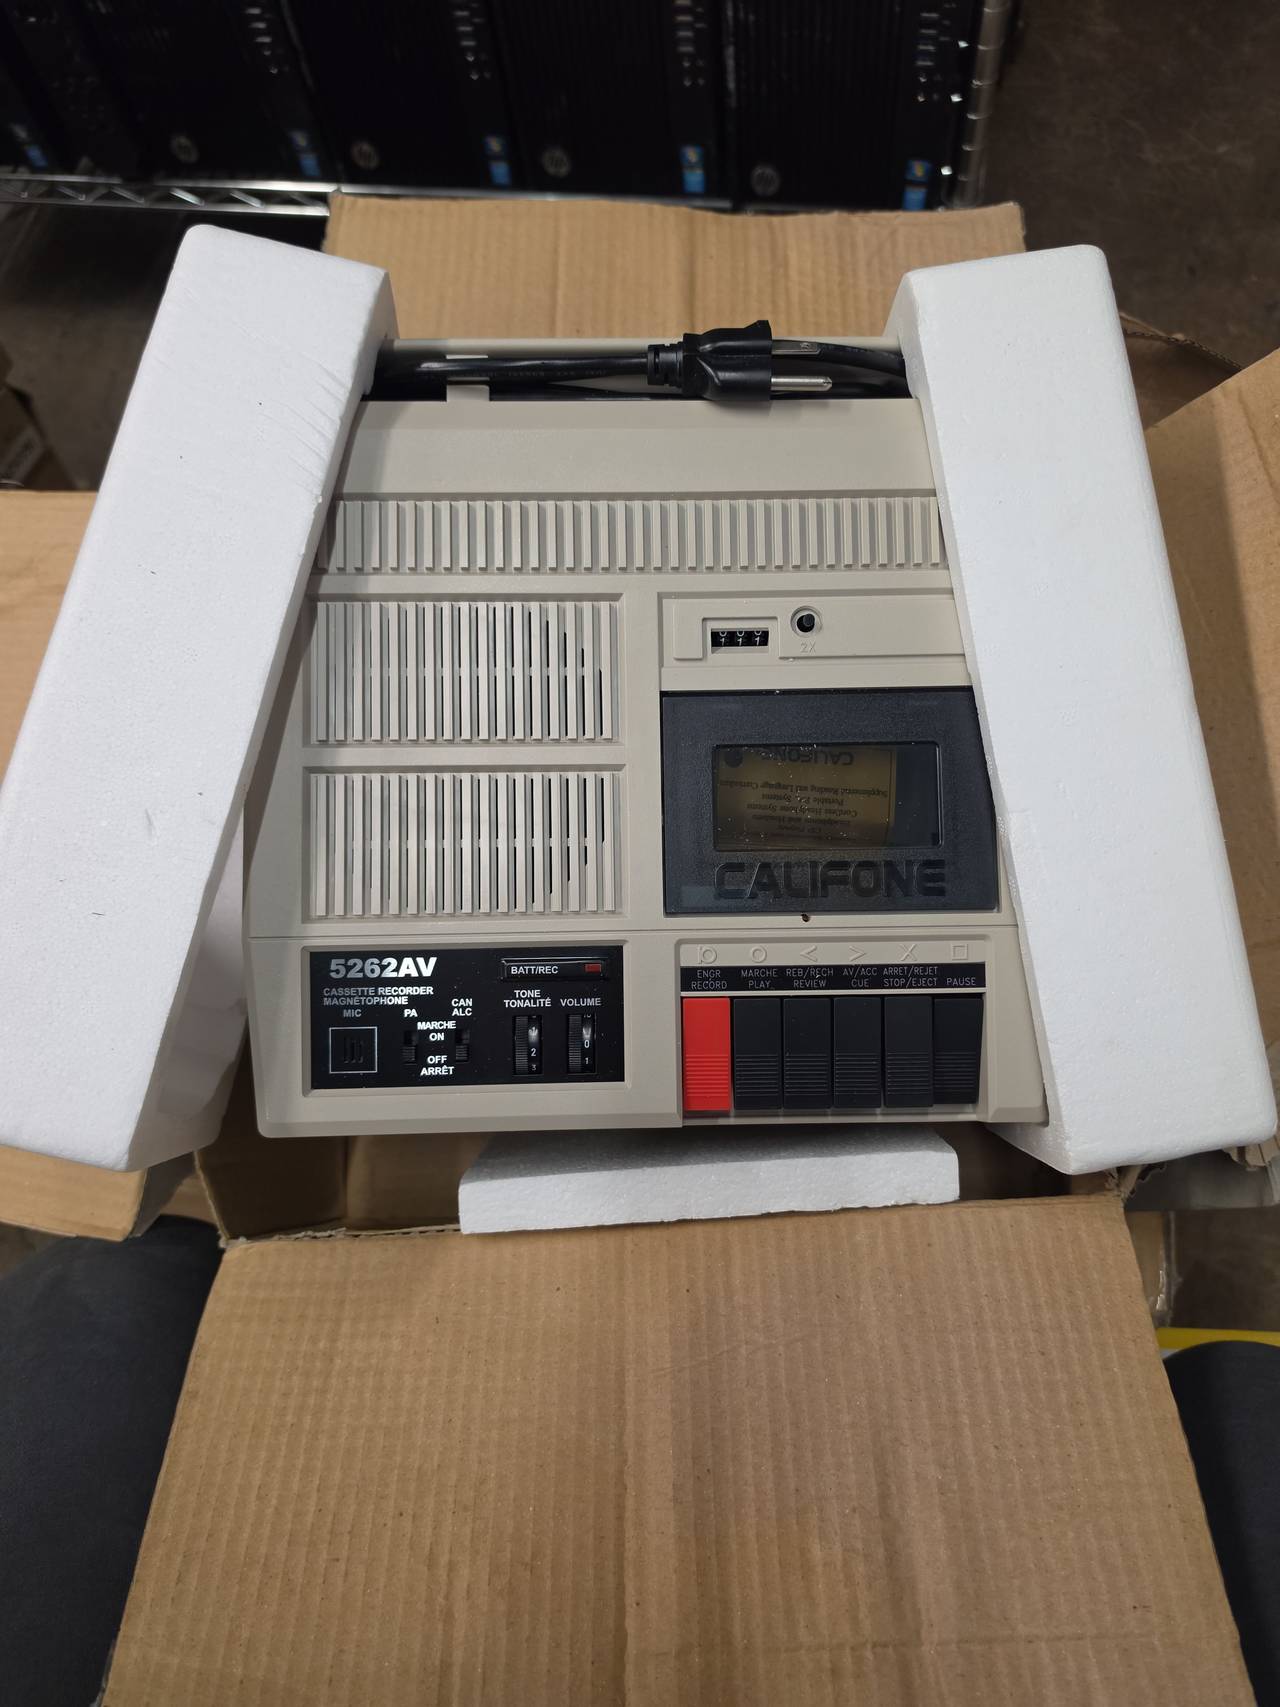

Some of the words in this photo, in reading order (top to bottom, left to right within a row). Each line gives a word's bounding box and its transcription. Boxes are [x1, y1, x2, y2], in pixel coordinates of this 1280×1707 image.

[800, 642, 816, 653] 2X
[714, 859, 946, 900] CALIFONE
[329, 957, 437, 979] 5262AV
[511, 966, 558, 975] BATT/REC
[843, 966, 877, 978] AV/ACC
[697, 969, 721, 979] ENGR
[741, 968, 778, 978] MARCHE
[691, 981, 728, 990] RECORD
[748, 980, 771, 989] PLAY
[793, 979, 827, 989] REVIEW
[851, 979, 870, 988] CUE
[883, 977, 938, 989] STOP/EJECT
[946, 977, 977, 986] PAUSE
[323, 988, 375, 996] CASSETTE
[378, 986, 434, 996] RECORDER
[514, 990, 541, 998] TONE
[451, 998, 473, 1007] CAN
[504, 997, 552, 1008] TONALITÉ
[560, 998, 601, 1007] VOLUME
[343, 1009, 362, 1018] MIC
[404, 1009, 418, 1018] PA
[452, 1008, 473, 1016] ALC
[417, 1021, 456, 1030] MARCHE
[429, 1032, 445, 1041] ON
[531, 1047, 537, 1057] 2
[427, 1055, 448, 1064] OFF
[420, 1065, 455, 1076] ARRÊT
